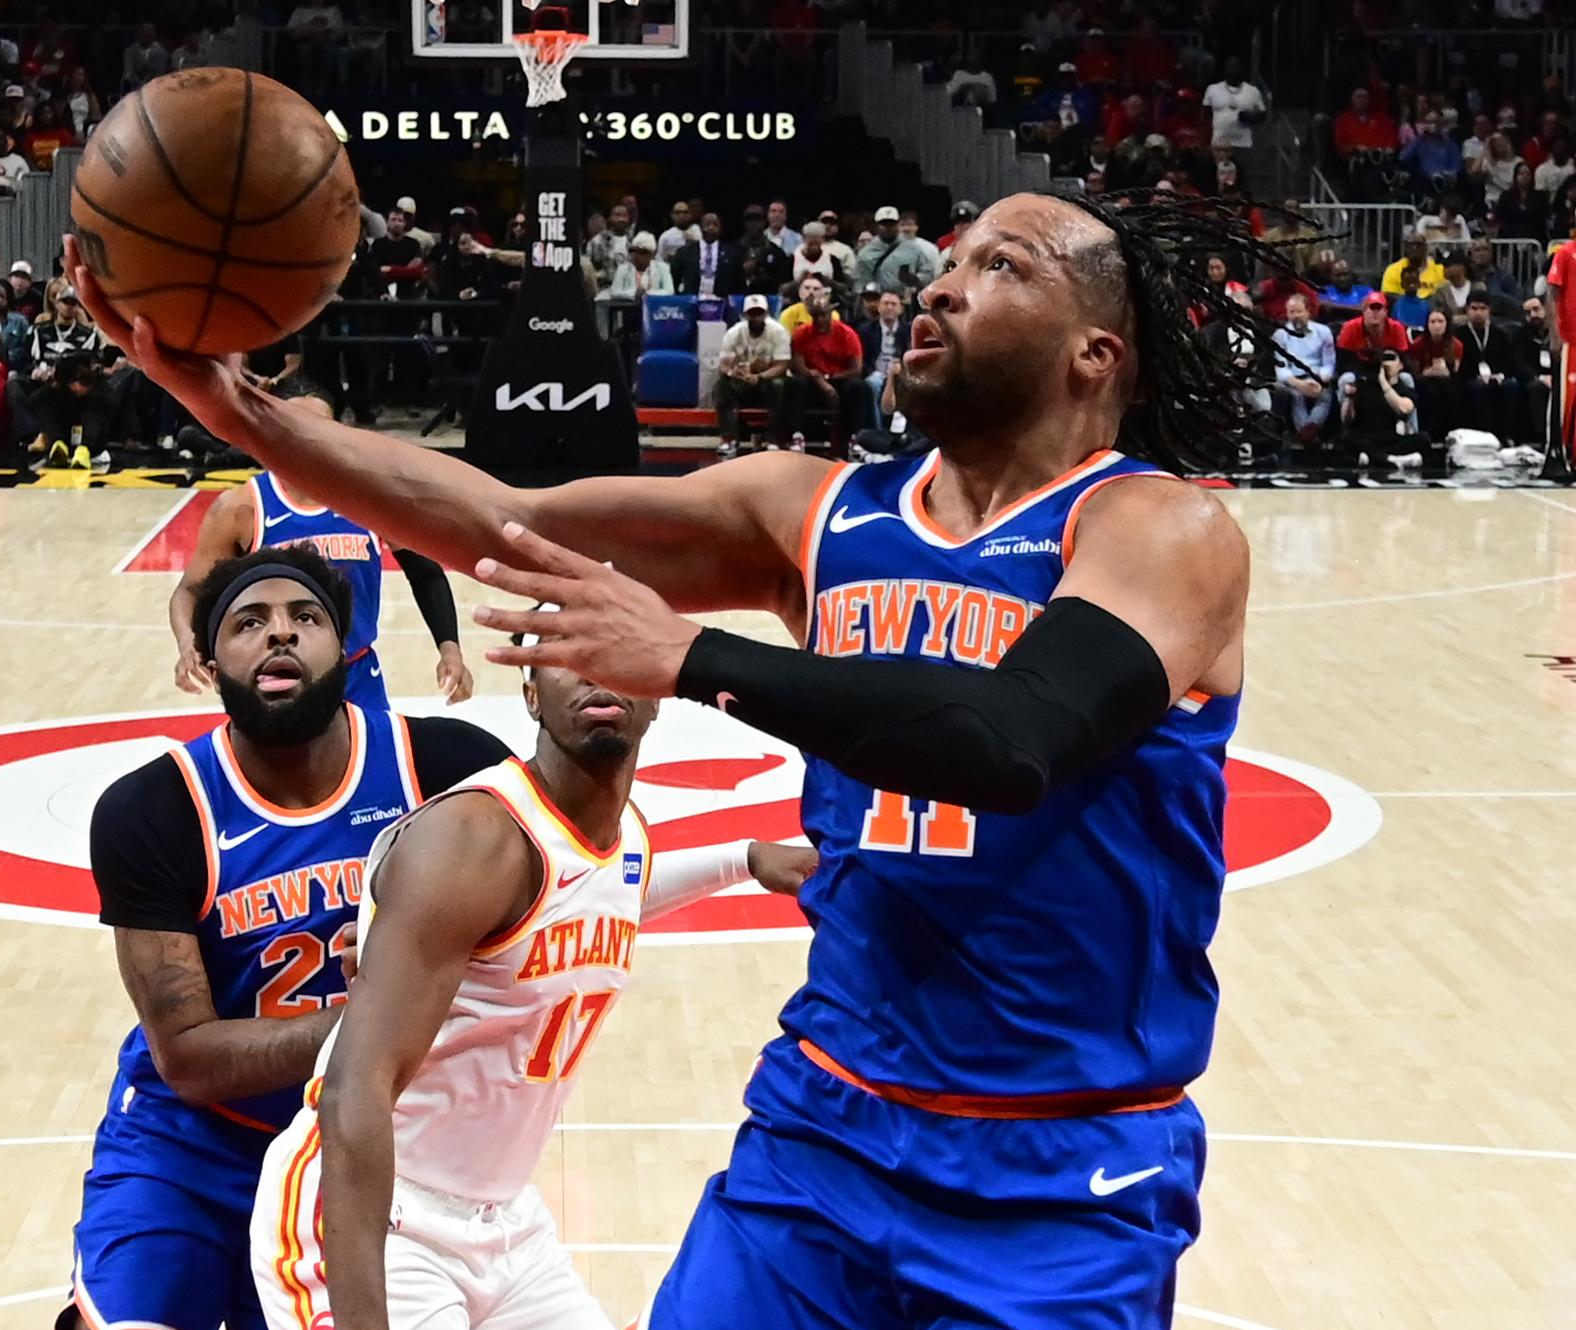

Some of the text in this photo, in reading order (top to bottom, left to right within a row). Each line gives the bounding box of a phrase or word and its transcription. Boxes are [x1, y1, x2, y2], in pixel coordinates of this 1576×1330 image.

[361, 110, 511, 141] DELTA
[537, 191, 567, 218] GET
[537, 216, 567, 242] THE
[545, 242, 574, 272] App
[528, 316, 574, 334] Google
[979, 543, 1012, 558] abu
[1012, 538, 1061, 555] dhabi
[814, 579, 1047, 670] NEW YOR
[215, 856, 368, 940] NEW YO
[514, 914, 638, 984] ATLANT
[524, 988, 618, 1084] 17
